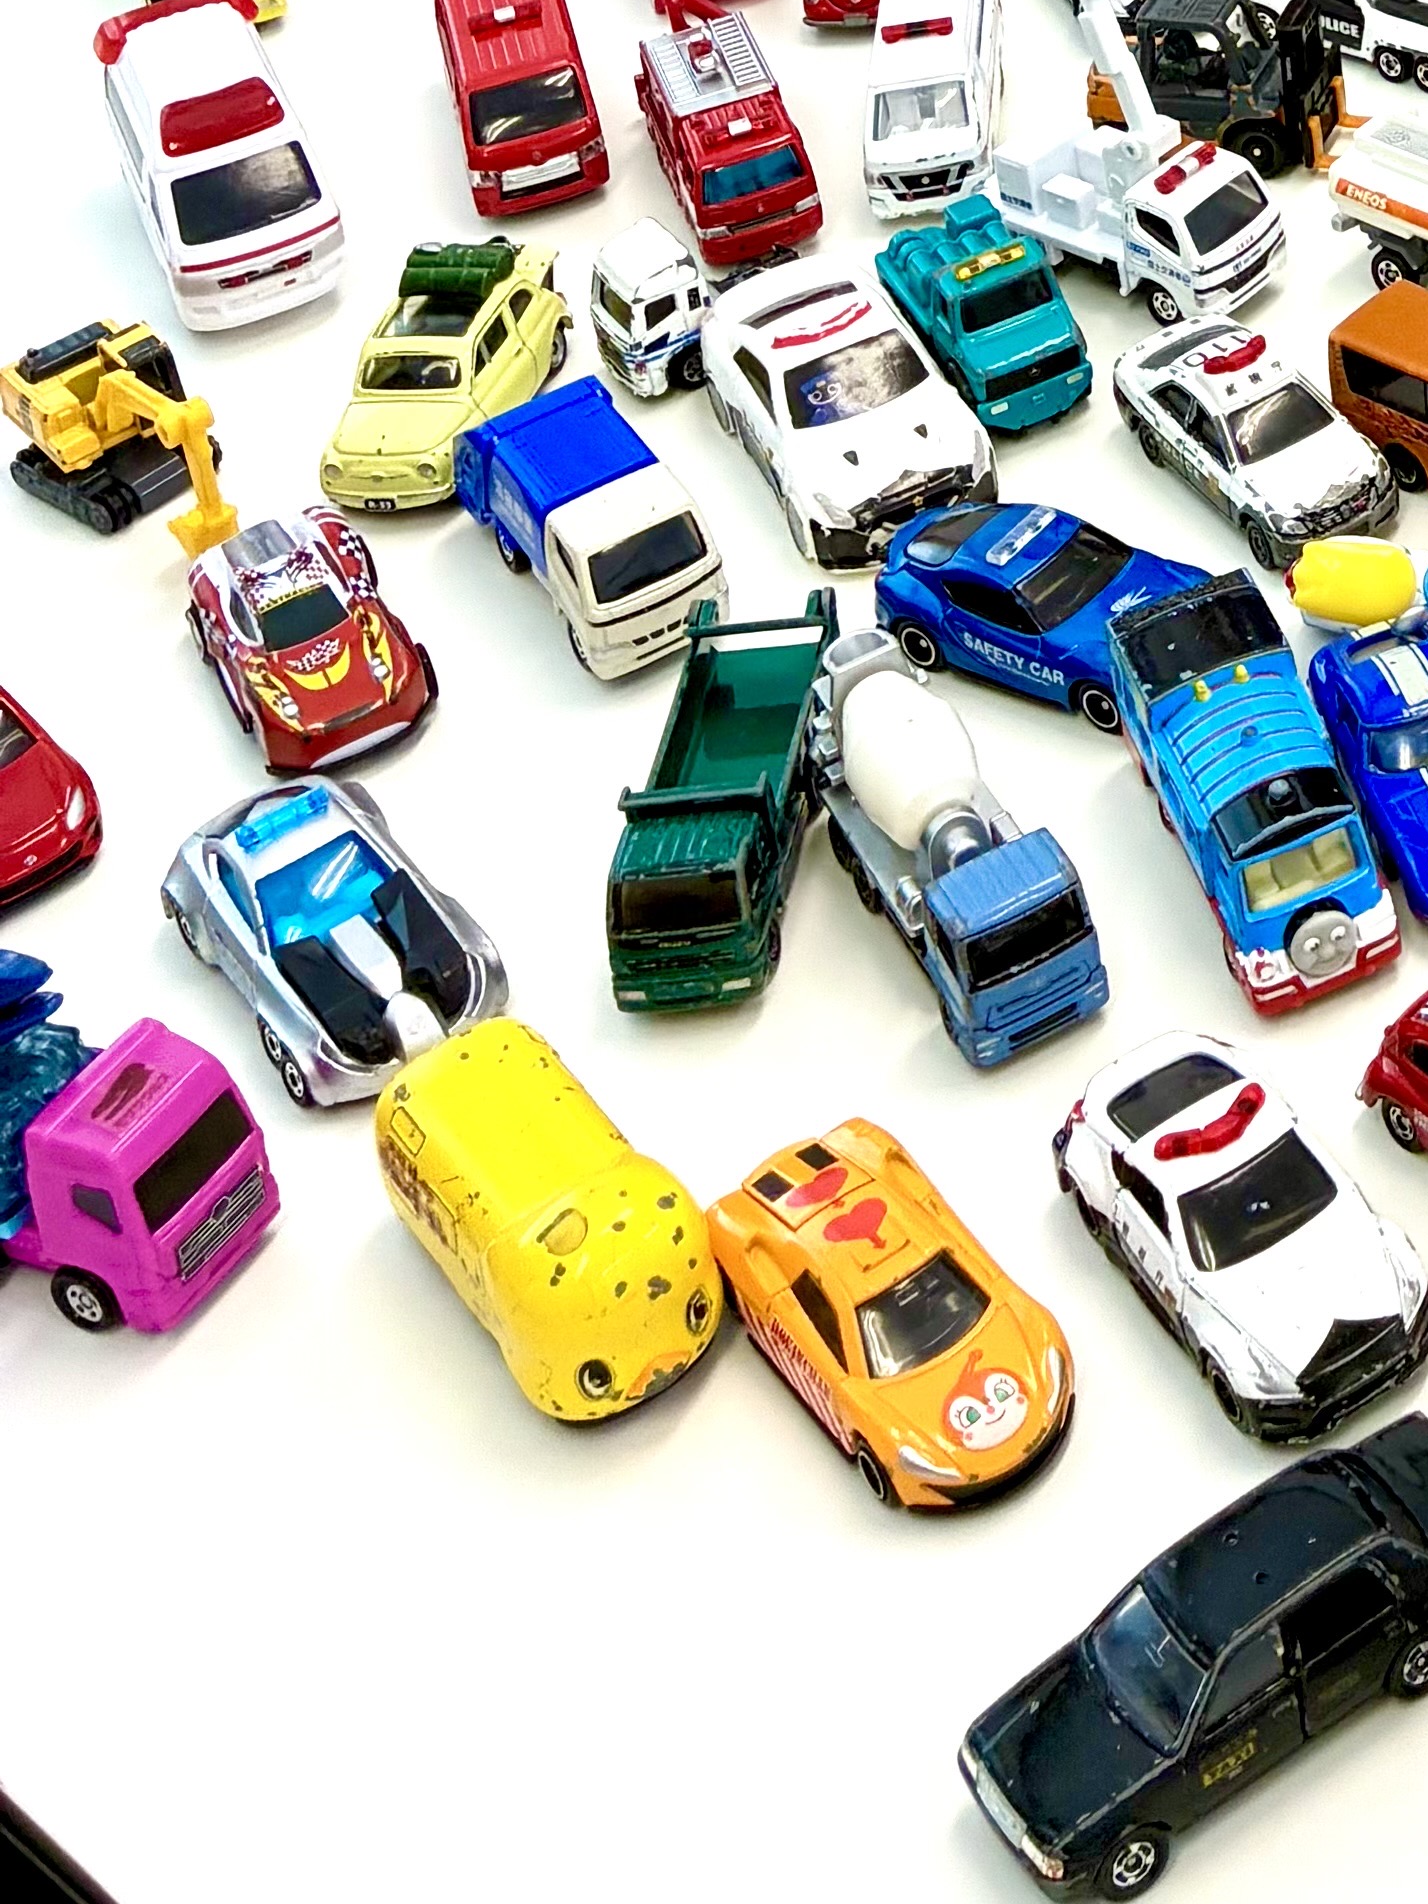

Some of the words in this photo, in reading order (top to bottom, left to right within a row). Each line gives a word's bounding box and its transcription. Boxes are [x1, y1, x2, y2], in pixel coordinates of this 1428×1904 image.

[1346, 183, 1388, 210] ENEOS
[963, 630, 1025, 671] SAFETY
[1028, 660, 1066, 687] CAR
